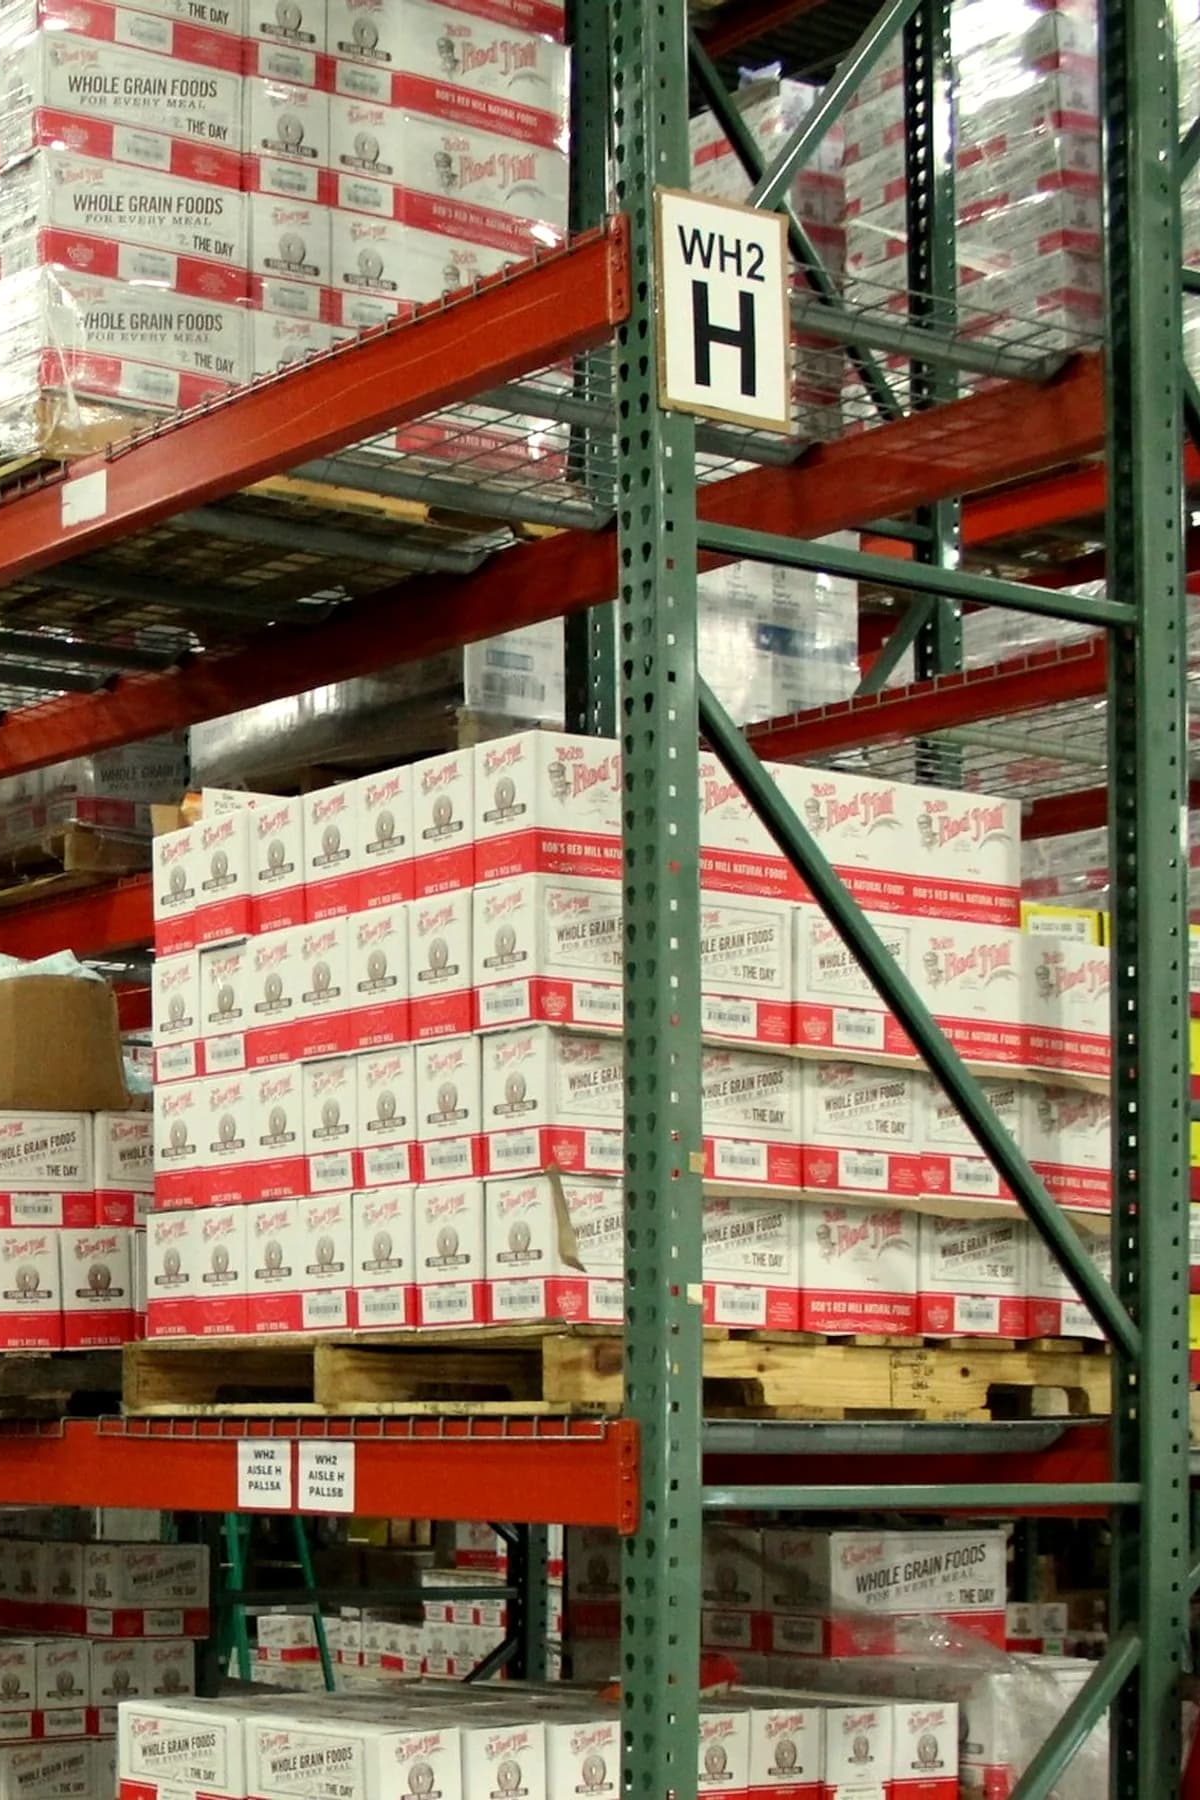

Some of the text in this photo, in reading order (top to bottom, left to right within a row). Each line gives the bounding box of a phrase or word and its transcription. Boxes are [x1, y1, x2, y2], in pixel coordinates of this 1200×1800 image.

[189, 2, 229, 25] THE DAY
[460, 40, 538, 76] Red Mill
[68, 75, 217, 98] WHOLE GRAIN FOODS
[80, 95, 110, 105] FOR
[166, 98, 206, 110] MEAL
[187, 118, 228, 142] THE DAY
[460, 152, 538, 189] Red Mill
[73, 194, 223, 215] WHOLE GRAIN FOODS
[85, 214, 115, 224] FOR
[172, 216, 212, 226] MEAL
[193, 235, 234, 258] THE DAY
[678, 225, 765, 282] WH2
[130, 313, 173, 331] GRAIN
[177, 314, 223, 332] FOODS
[692, 280, 756, 397] H
[195, 352, 234, 374] THE DAY
[572, 756, 609, 798] Red
[826, 787, 896, 832] Red Mill
[938, 804, 1006, 847] Red Mill
[715, 861, 788, 880] MILL NATURAL FOODS
[854, 878, 904, 896] NATURAL FOODS
[912, 887, 934, 898] BOB'S
[935, 889, 949, 900] RED
[949, 891, 965, 902] MILL
[993, 894, 1016, 907] FOODS
[556, 919, 616, 942] WHOLE GRAIN
[818, 952, 847, 970] WHOLE
[944, 940, 1011, 984] Red Mill
[742, 966, 776, 981] THE DAY
[956, 1030, 970, 1041] MILL
[998, 1033, 1021, 1046] FOODS
[730, 1075, 755, 1094] GRAIN
[757, 1070, 784, 1087] FOODS
[824, 1082, 905, 1112] WHOLE GRAIN FOODS
[752, 1108, 785, 1123] THE DAY
[874, 1120, 905, 1135] THE DAY
[24, 1138, 48, 1155] GRAIN
[50, 1131, 76, 1147] FOODS
[119, 1143, 148, 1161] WHOLE
[46, 1164, 78, 1177] THE DAY
[730, 1221, 754, 1237] GRAIN
[756, 1213, 783, 1232] FOODS
[838, 1210, 903, 1257] Red Mill
[941, 1242, 965, 1258] WHOLE
[967, 1236, 988, 1252] GRAIN
[752, 1253, 783, 1267] THE DAY
[810, 1300, 829, 1313] BOB'S
[830, 1302, 846, 1313] RED
[846, 1303, 863, 1314] MILL
[891, 1304, 911, 1316] FOODS
[254, 1450, 275, 1459] WH2
[315, 1455, 337, 1465] WH2
[247, 1466, 281, 1475] AISLE H
[309, 1471, 344, 1481] AISLE H
[248, 1481, 281, 1490] PAL15A
[309, 1486, 343, 1497] PAL15B
[856, 1544, 986, 1594] WHOLE GRAIN FOODS
[960, 1589, 995, 1602] THE DAY
[141, 1733, 216, 1756] WHOLE GRAIN FOODS
[271, 1747, 352, 1772] WHOLE GRAIN FOODS
[17, 1771, 39, 1784] WHOLE
[42, 1763, 61, 1778] GRAIN
[190, 1768, 202, 1779] THE
[325, 1784, 354, 1797] THE DAY
